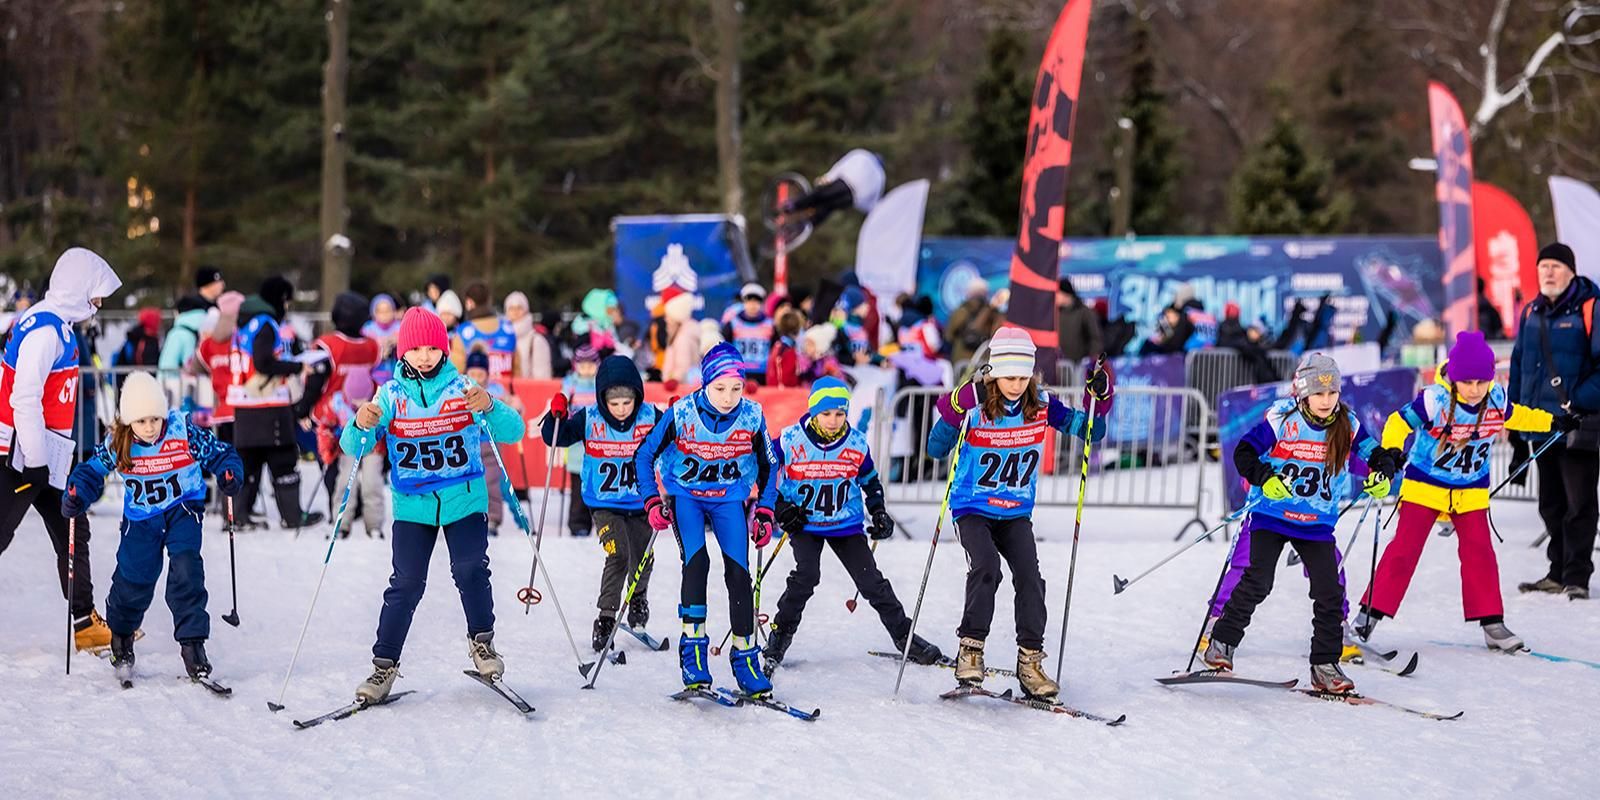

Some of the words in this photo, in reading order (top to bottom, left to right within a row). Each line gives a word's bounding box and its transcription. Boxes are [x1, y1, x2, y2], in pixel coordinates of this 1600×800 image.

[396, 435, 469, 471] 253
[978, 449, 1040, 489] 242
[1433, 442, 1491, 474] 243
[125, 473, 182, 507] 251
[598, 461, 636, 492] 24
[798, 479, 851, 517] 240
